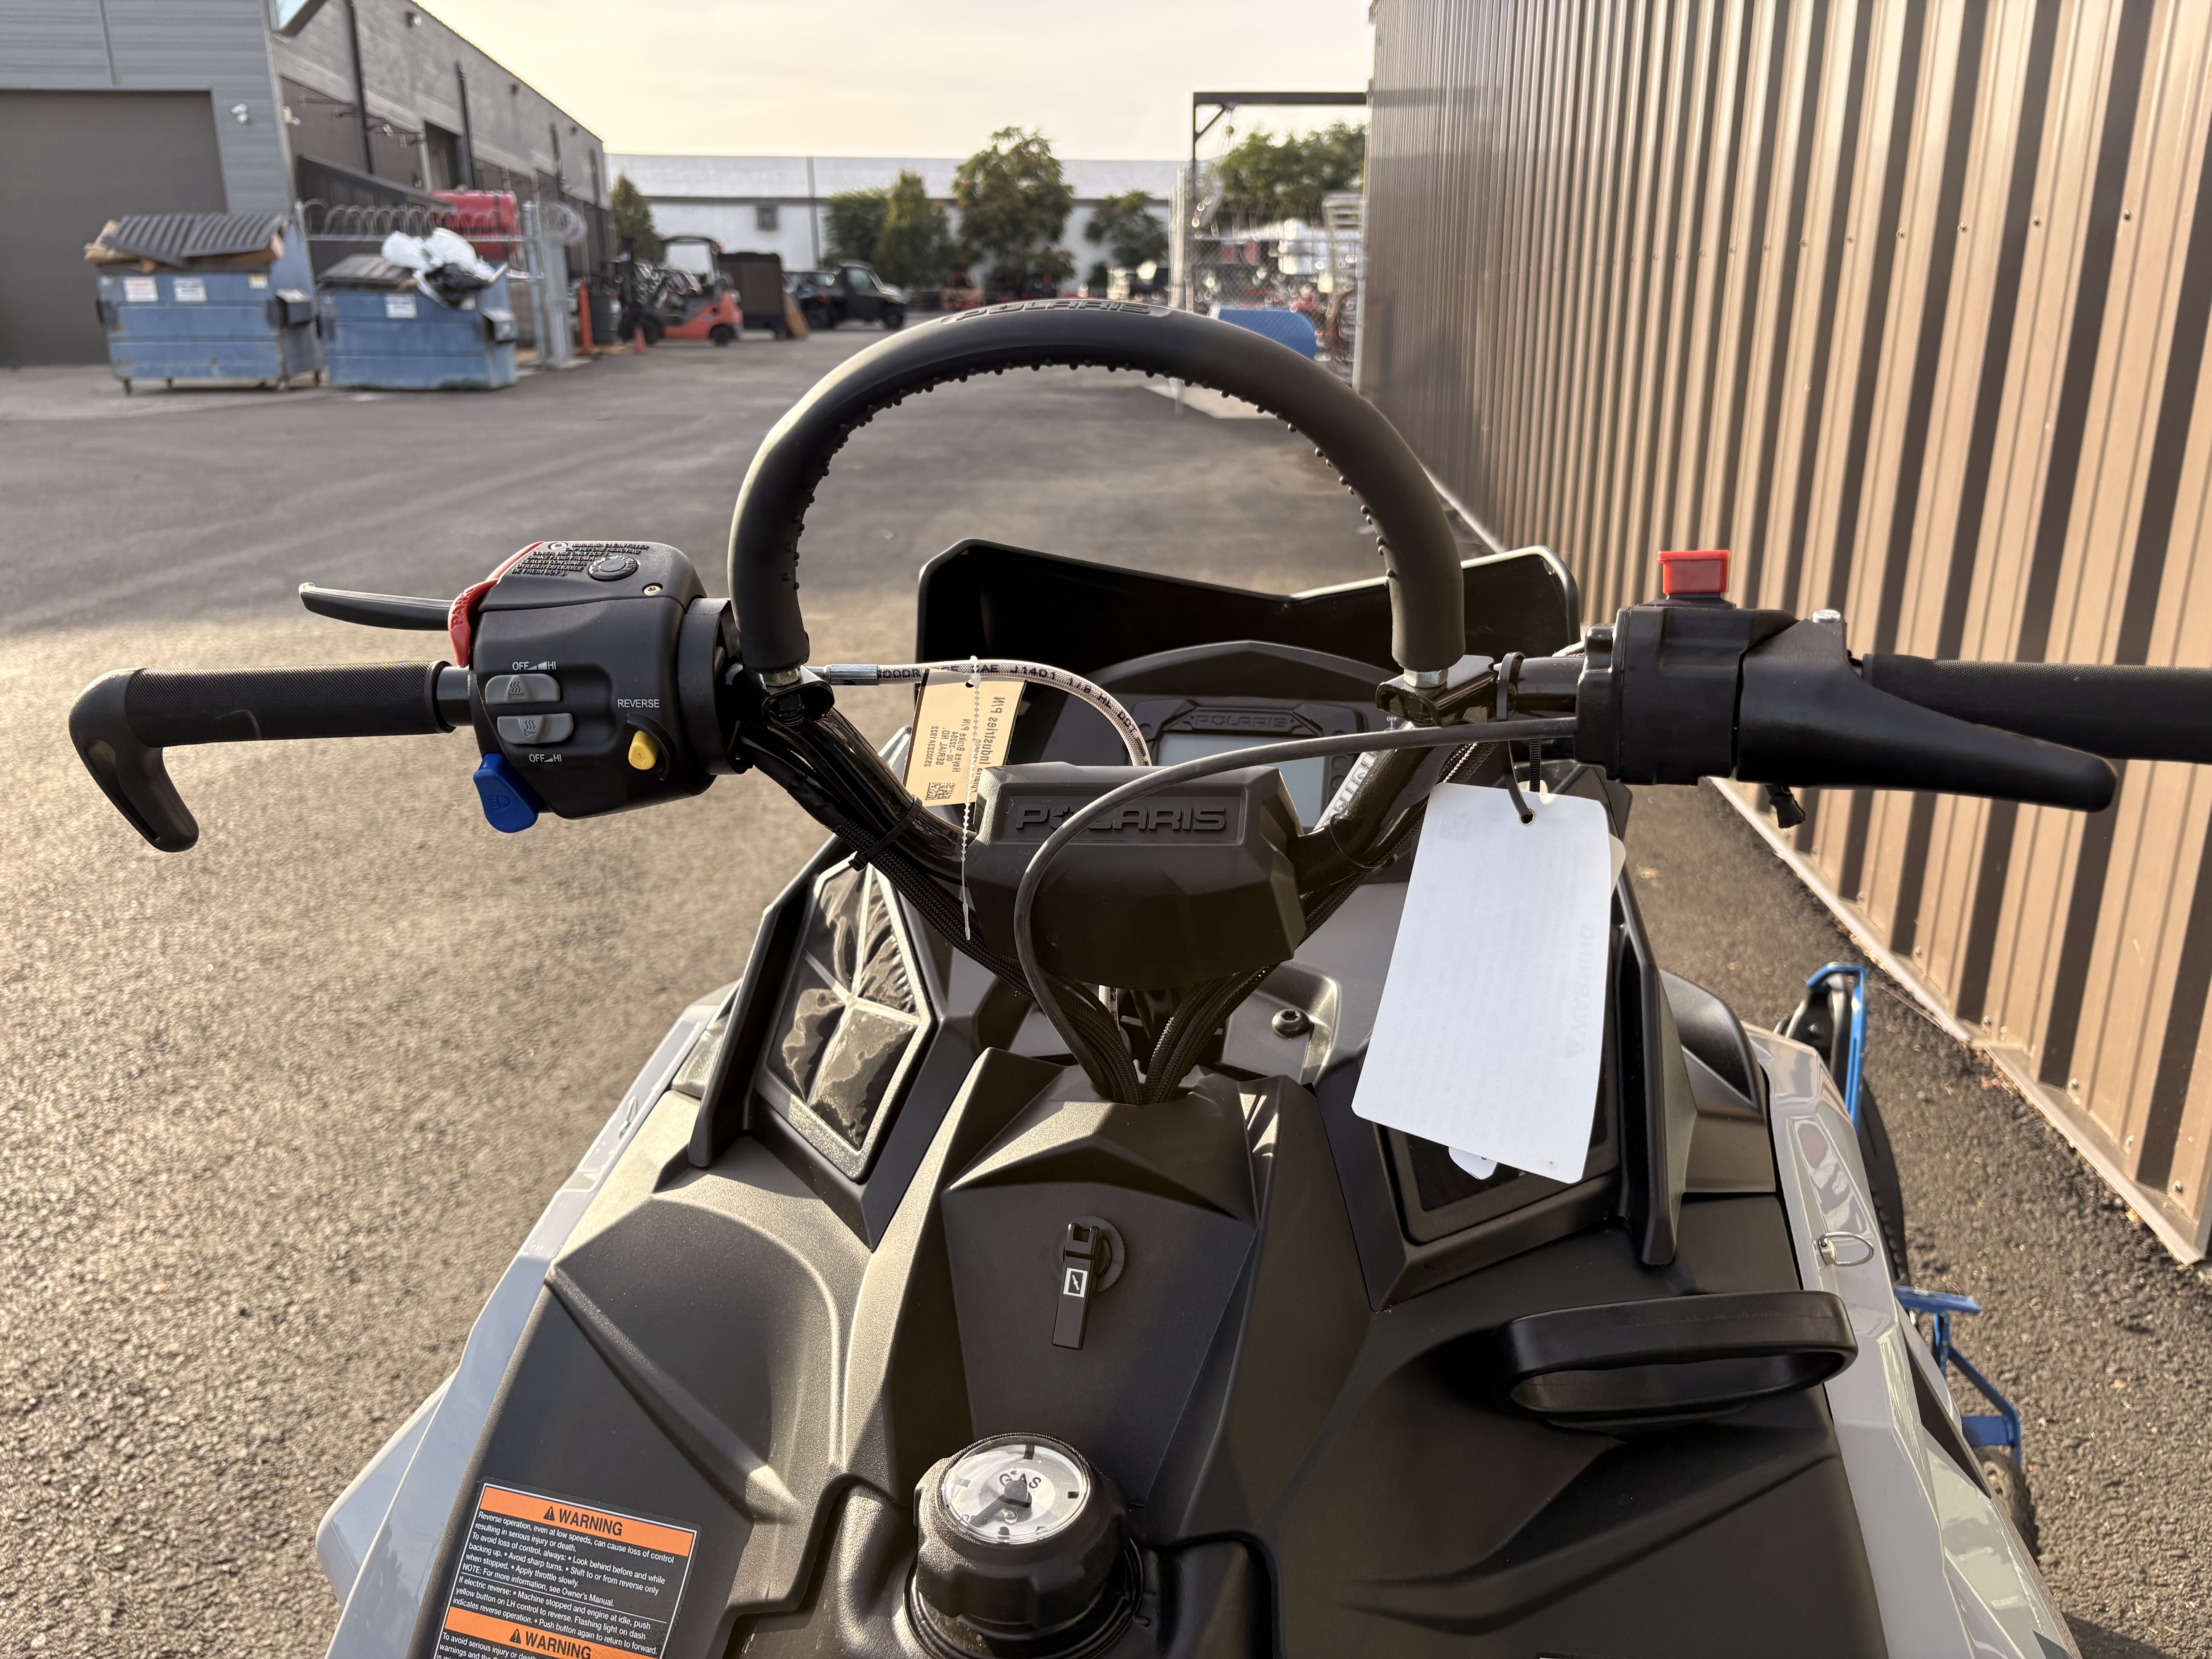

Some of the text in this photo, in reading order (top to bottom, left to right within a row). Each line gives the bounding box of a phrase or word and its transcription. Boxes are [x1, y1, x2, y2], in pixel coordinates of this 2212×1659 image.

[956, 300, 1151, 321] POLARIS
[451, 588, 474, 628] PARK
[512, 661, 556, 671] OFF HI
[618, 699, 660, 708] REVERSE
[1117, 711, 1137, 733] DOT
[1195, 714, 1288, 727] POLARIS
[529, 754, 562, 763] OFF HI
[999, 1473, 1041, 1489] GAS
[560, 1509, 623, 1536] WARNING
[475, 1523, 501, 1536] resulting
[501, 1527, 507, 1535] in
[508, 1531, 531, 1541] serious
[531, 1534, 549, 1547] injury
[557, 1541, 577, 1552] death.
[478, 1511, 502, 1523] Reverse
[503, 1518, 532, 1531] operation,
[533, 1525, 548, 1534] even
[556, 1529, 568, 1539] low
[568, 1534, 592, 1546] speeds,
[607, 1543, 627, 1553] cause
[627, 1546, 641, 1556] loss
[651, 1553, 674, 1564] control
[466, 1553, 579, 1588] when stopped. Apply throttle slowly.
[469, 1542, 492, 1556] backing
[493, 1549, 502, 1558] up.
[508, 1552, 527, 1563] Avoid
[527, 1557, 545, 1568] sharp
[546, 1561, 563, 1572] turns.
[570, 1566, 585, 1577] Shift
[586, 1570, 593, 1579] to
[603, 1574, 618, 1585] from
[619, 1580, 644, 1591] reverse
[644, 1586, 659, 1596] only
[472, 1531, 479, 1540] To
[480, 1535, 497, 1544] avoid
[497, 1537, 510, 1547] loss
[519, 1544, 542, 1556] control,
[543, 1549, 567, 1561] always:
[572, 1555, 588, 1566] Look
[589, 1559, 611, 1571] behind
[612, 1565, 633, 1577] before
[634, 1572, 647, 1580] and
[648, 1575, 665, 1584] while
[462, 1563, 614, 1607] NOTE: For more information, see Owner's Manual.
[455, 1587, 475, 1597] yellow
[476, 1591, 496, 1603] button
[506, 1599, 516, 1608] LH
[516, 1603, 539, 1614] control
[539, 1607, 546, 1616] to
[547, 1611, 572, 1623] reverse.
[574, 1616, 602, 1631] Flashing
[603, 1623, 618, 1633] light
[629, 1630, 646, 1640] dash
[459, 1575, 464, 1584] If
[464, 1578, 486, 1589] electric
[487, 1584, 512, 1595] reverse:
[517, 1590, 544, 1604] Machine
[545, 1599, 572, 1611] stopped
[573, 1606, 586, 1614] and
[587, 1609, 609, 1620] engine
[618, 1615, 632, 1627] idle,
[634, 1621, 651, 1630] push
[453, 1596, 656, 1654] indicates reverse operation. Push button again to return to forward.
[440, 1644, 467, 1657] warnings
[443, 1632, 450, 1640] To
[450, 1636, 468, 1645] avoid
[469, 1641, 491, 1652] serious
[492, 1645, 510, 1658] injury
[526, 1631, 592, 1659] WARNING
